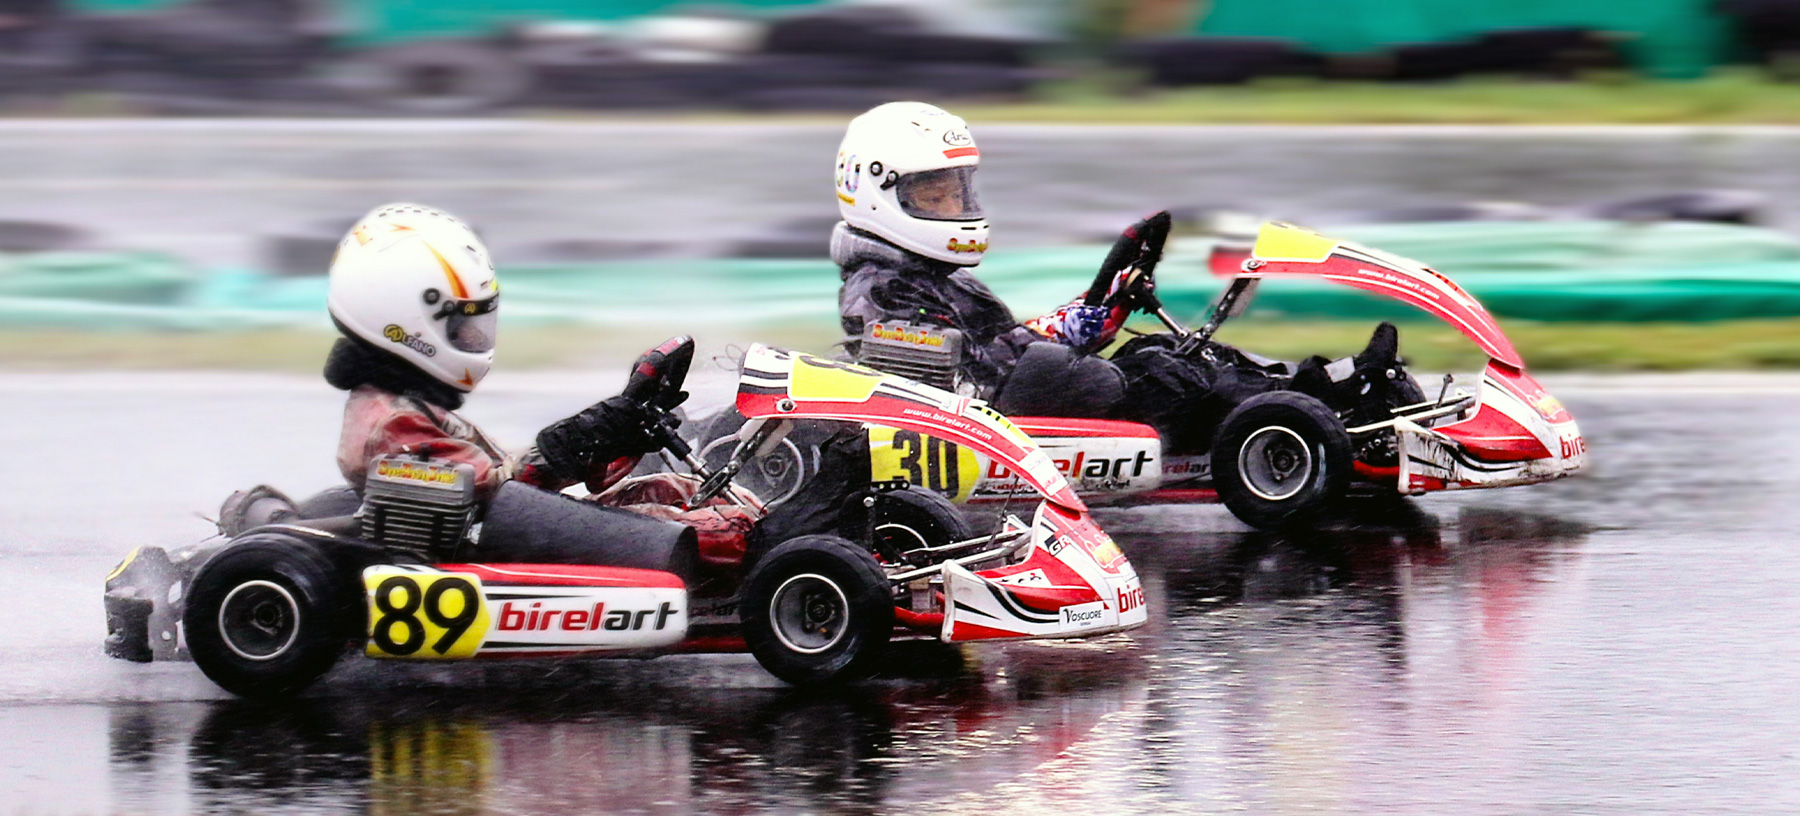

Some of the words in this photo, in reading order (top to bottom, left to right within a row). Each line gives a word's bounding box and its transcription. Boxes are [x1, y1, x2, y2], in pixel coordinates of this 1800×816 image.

[903, 407, 993, 440] www.birelart.com
[892, 429, 960, 499] 30
[987, 450, 1153, 479] belart
[373, 575, 480, 656] 89
[496, 601, 679, 632] birelart
